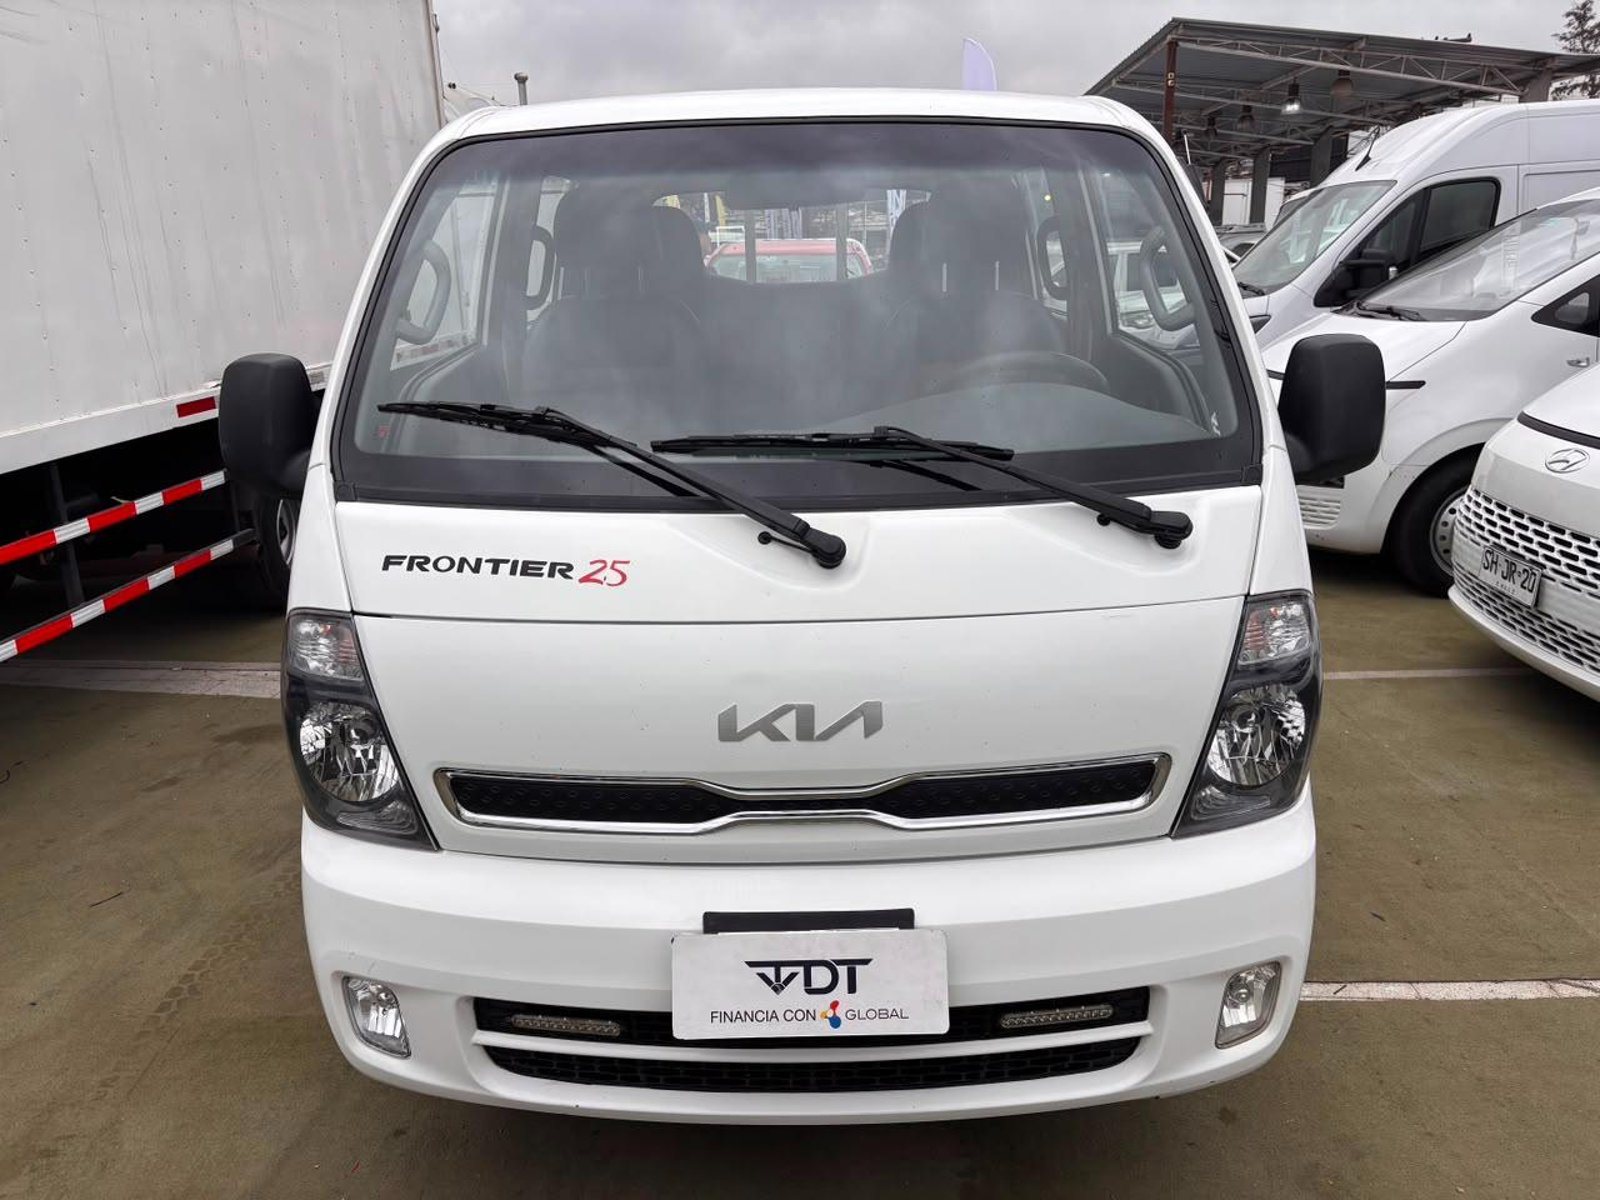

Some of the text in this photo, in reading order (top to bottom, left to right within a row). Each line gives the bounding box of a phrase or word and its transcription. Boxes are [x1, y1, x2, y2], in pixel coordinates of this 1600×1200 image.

[381, 554, 575, 580] FRONTIER
[718, 701, 883, 742] KIA
[710, 1008, 909, 1023] FINANCIA CON GLOBAL
